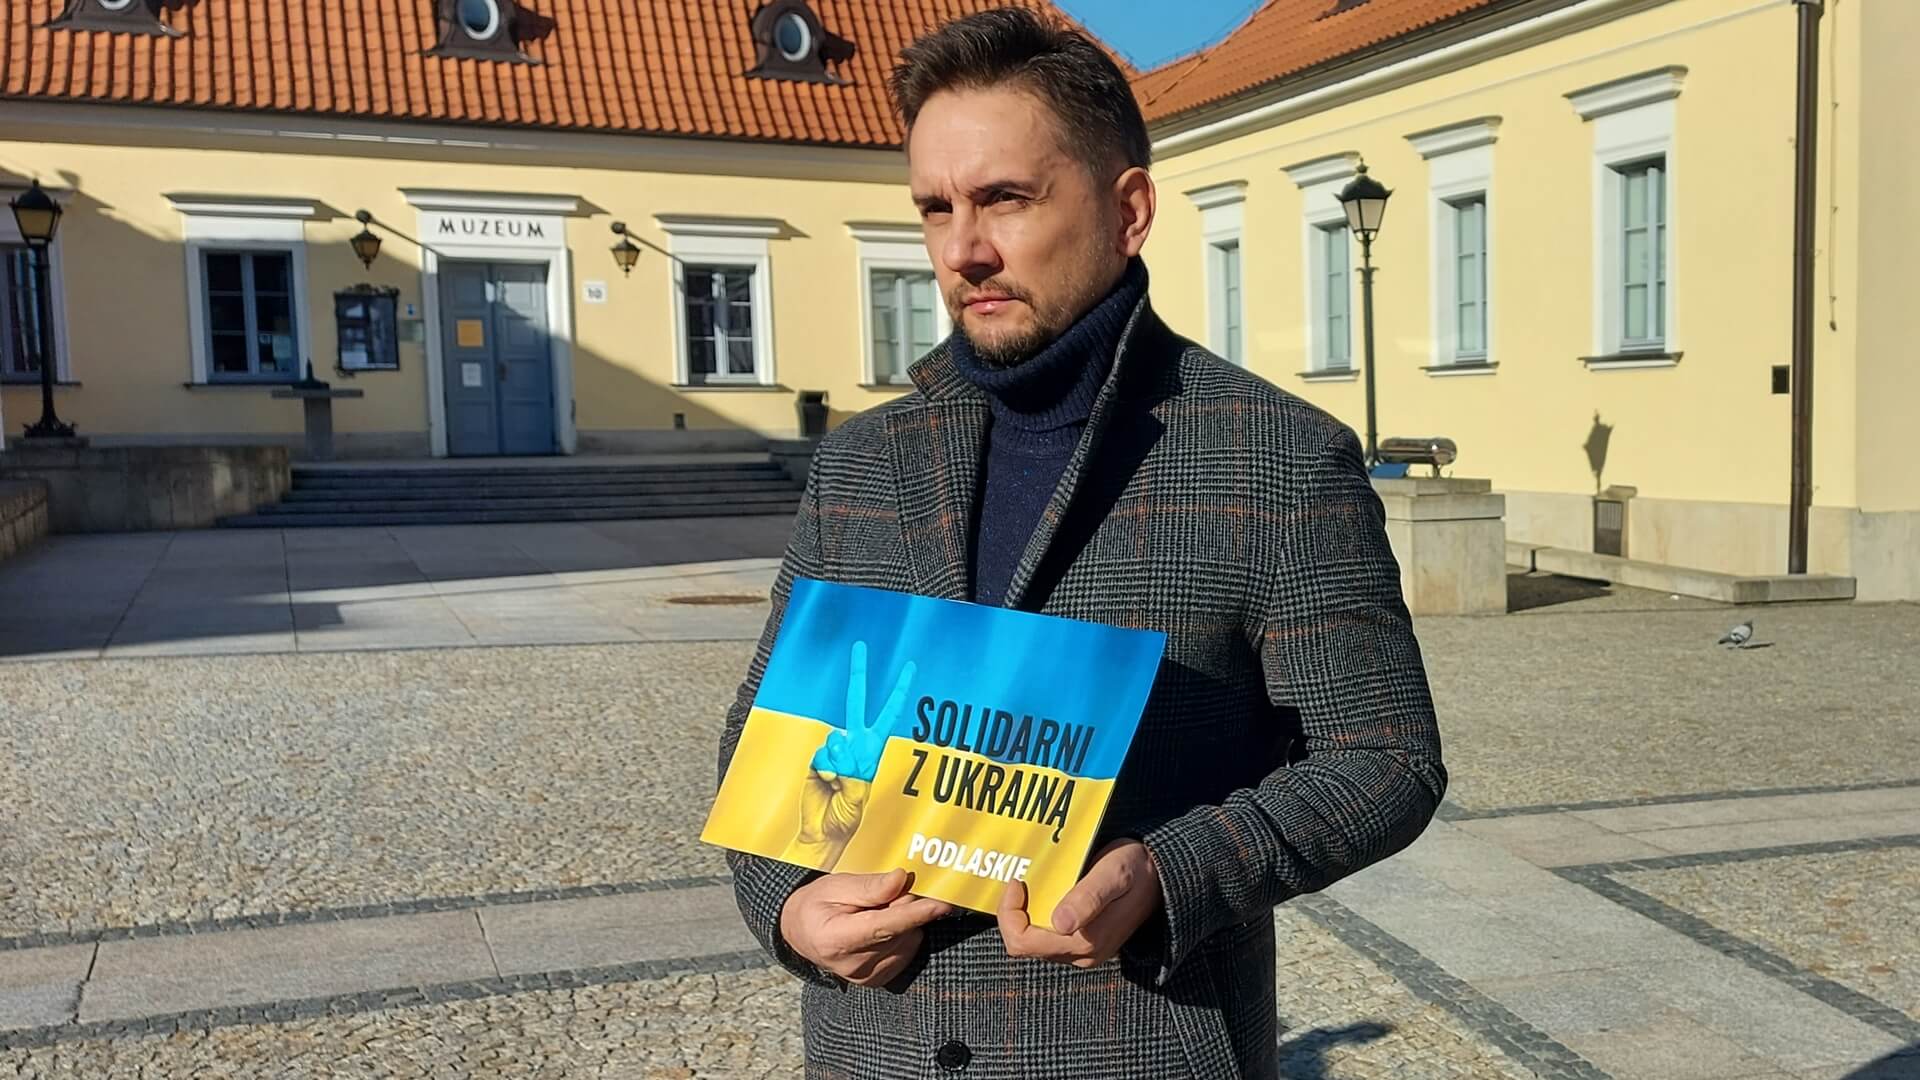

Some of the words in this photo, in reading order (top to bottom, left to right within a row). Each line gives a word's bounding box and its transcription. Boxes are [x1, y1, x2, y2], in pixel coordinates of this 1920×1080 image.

[438, 217, 545, 238] MUZEUM
[911, 695, 1096, 774] SOLIDARNI
[902, 748, 929, 798] Z
[932, 754, 1077, 844] UKRAINĄ
[906, 831, 1032, 883] PODLASKIE
